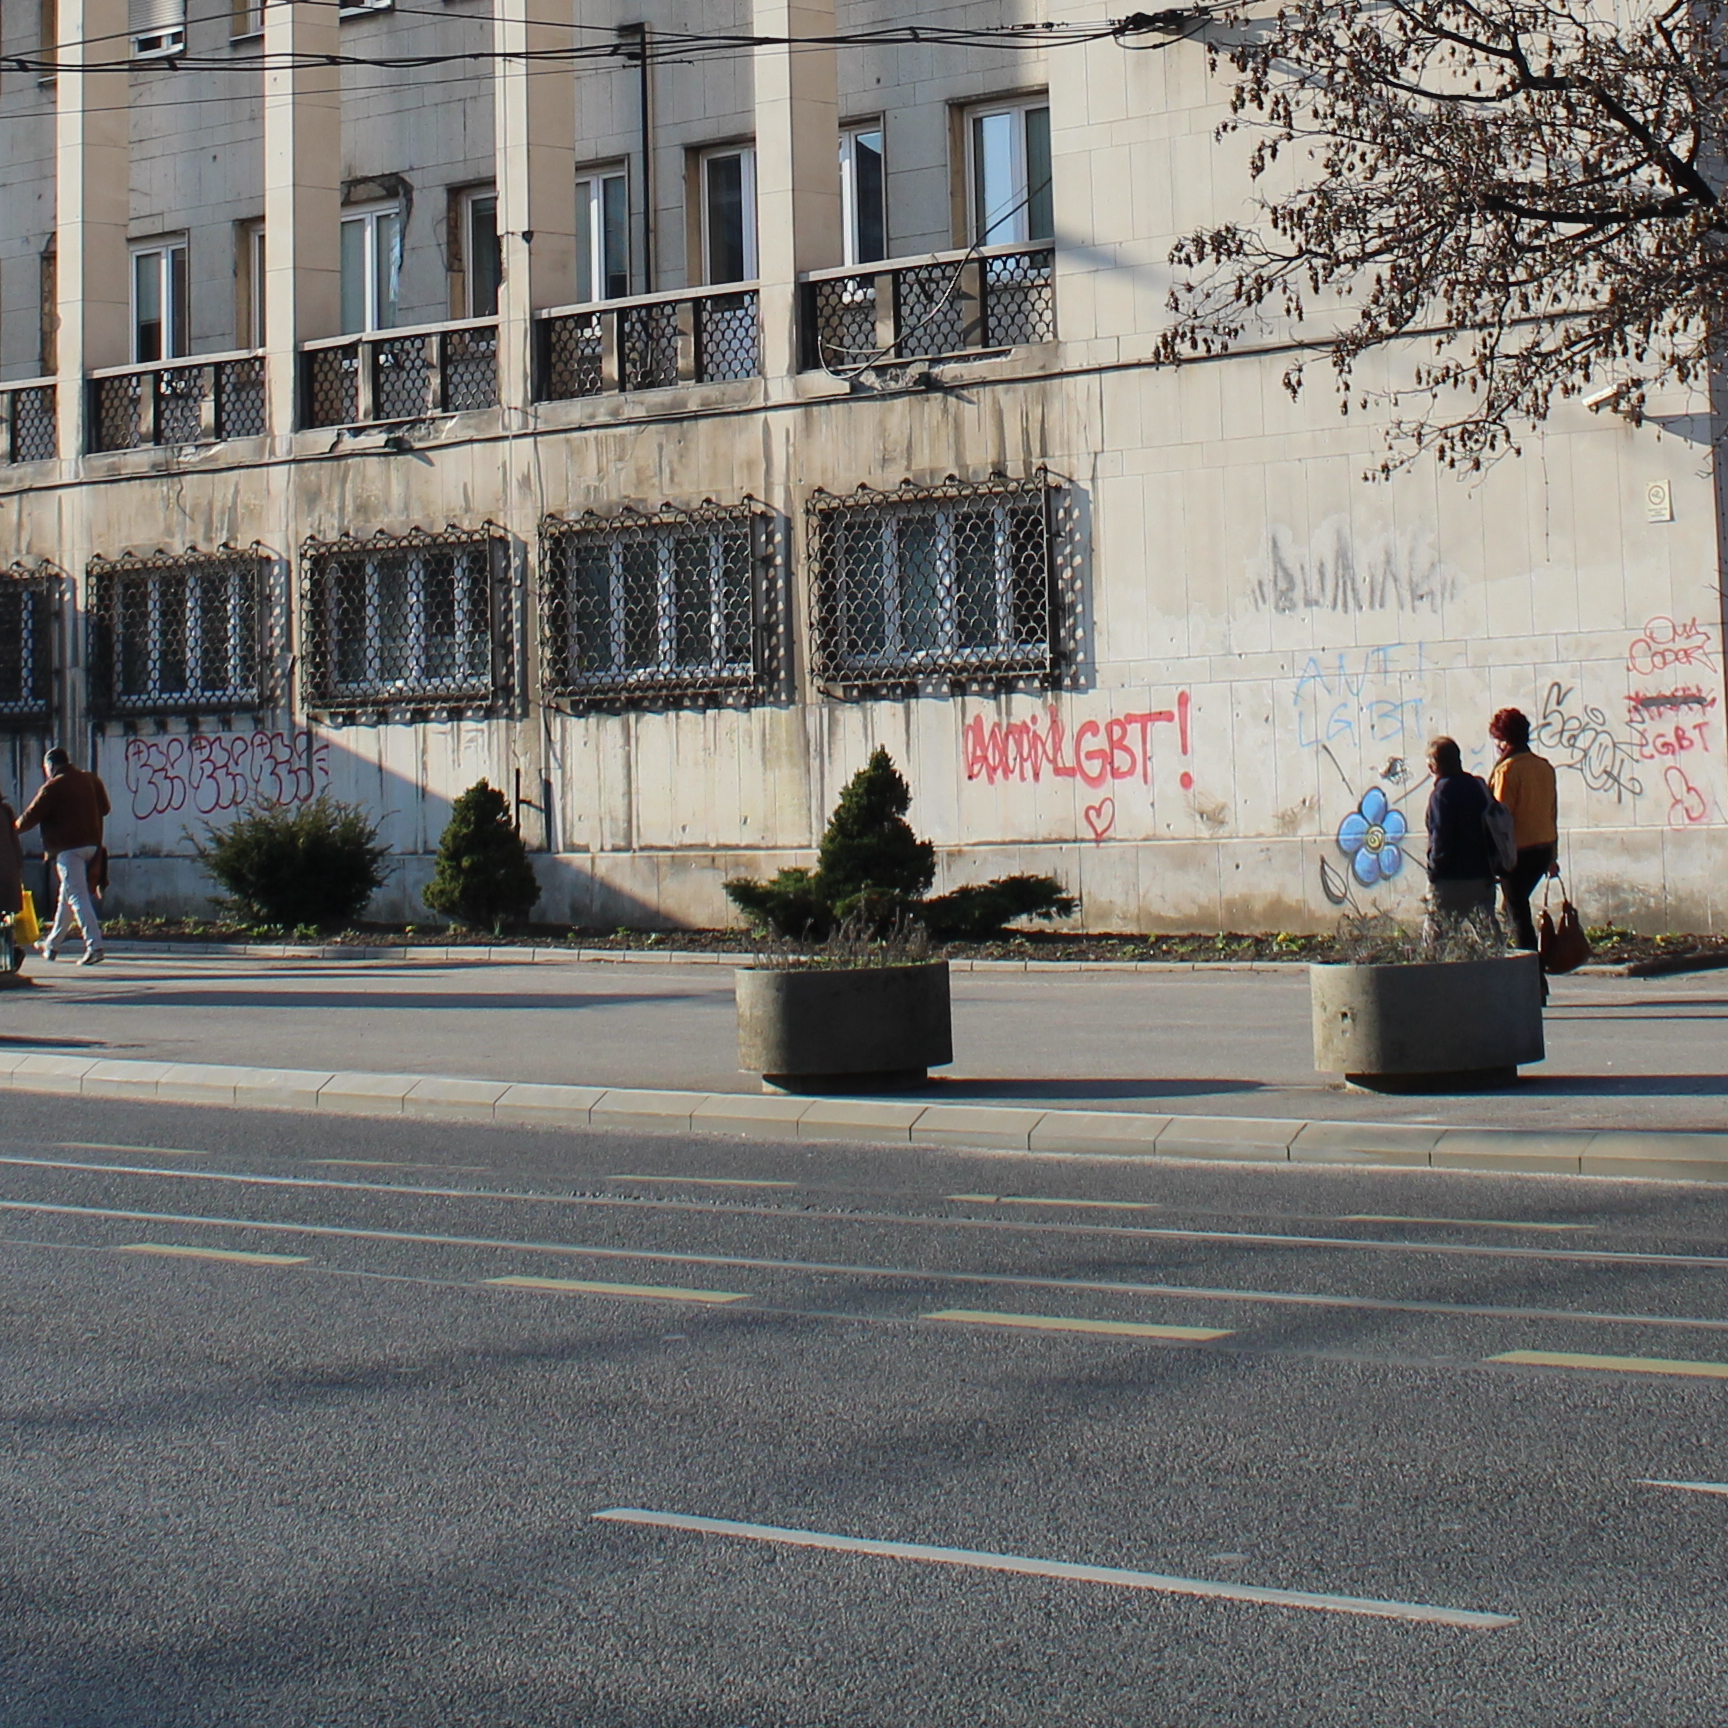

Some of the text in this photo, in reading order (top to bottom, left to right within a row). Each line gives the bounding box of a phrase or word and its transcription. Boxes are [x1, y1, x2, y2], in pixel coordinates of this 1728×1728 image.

[1292, 640, 1423, 707] ANTI
[1298, 698, 1424, 748] LGBT
[1639, 721, 1711, 760] LGBT
